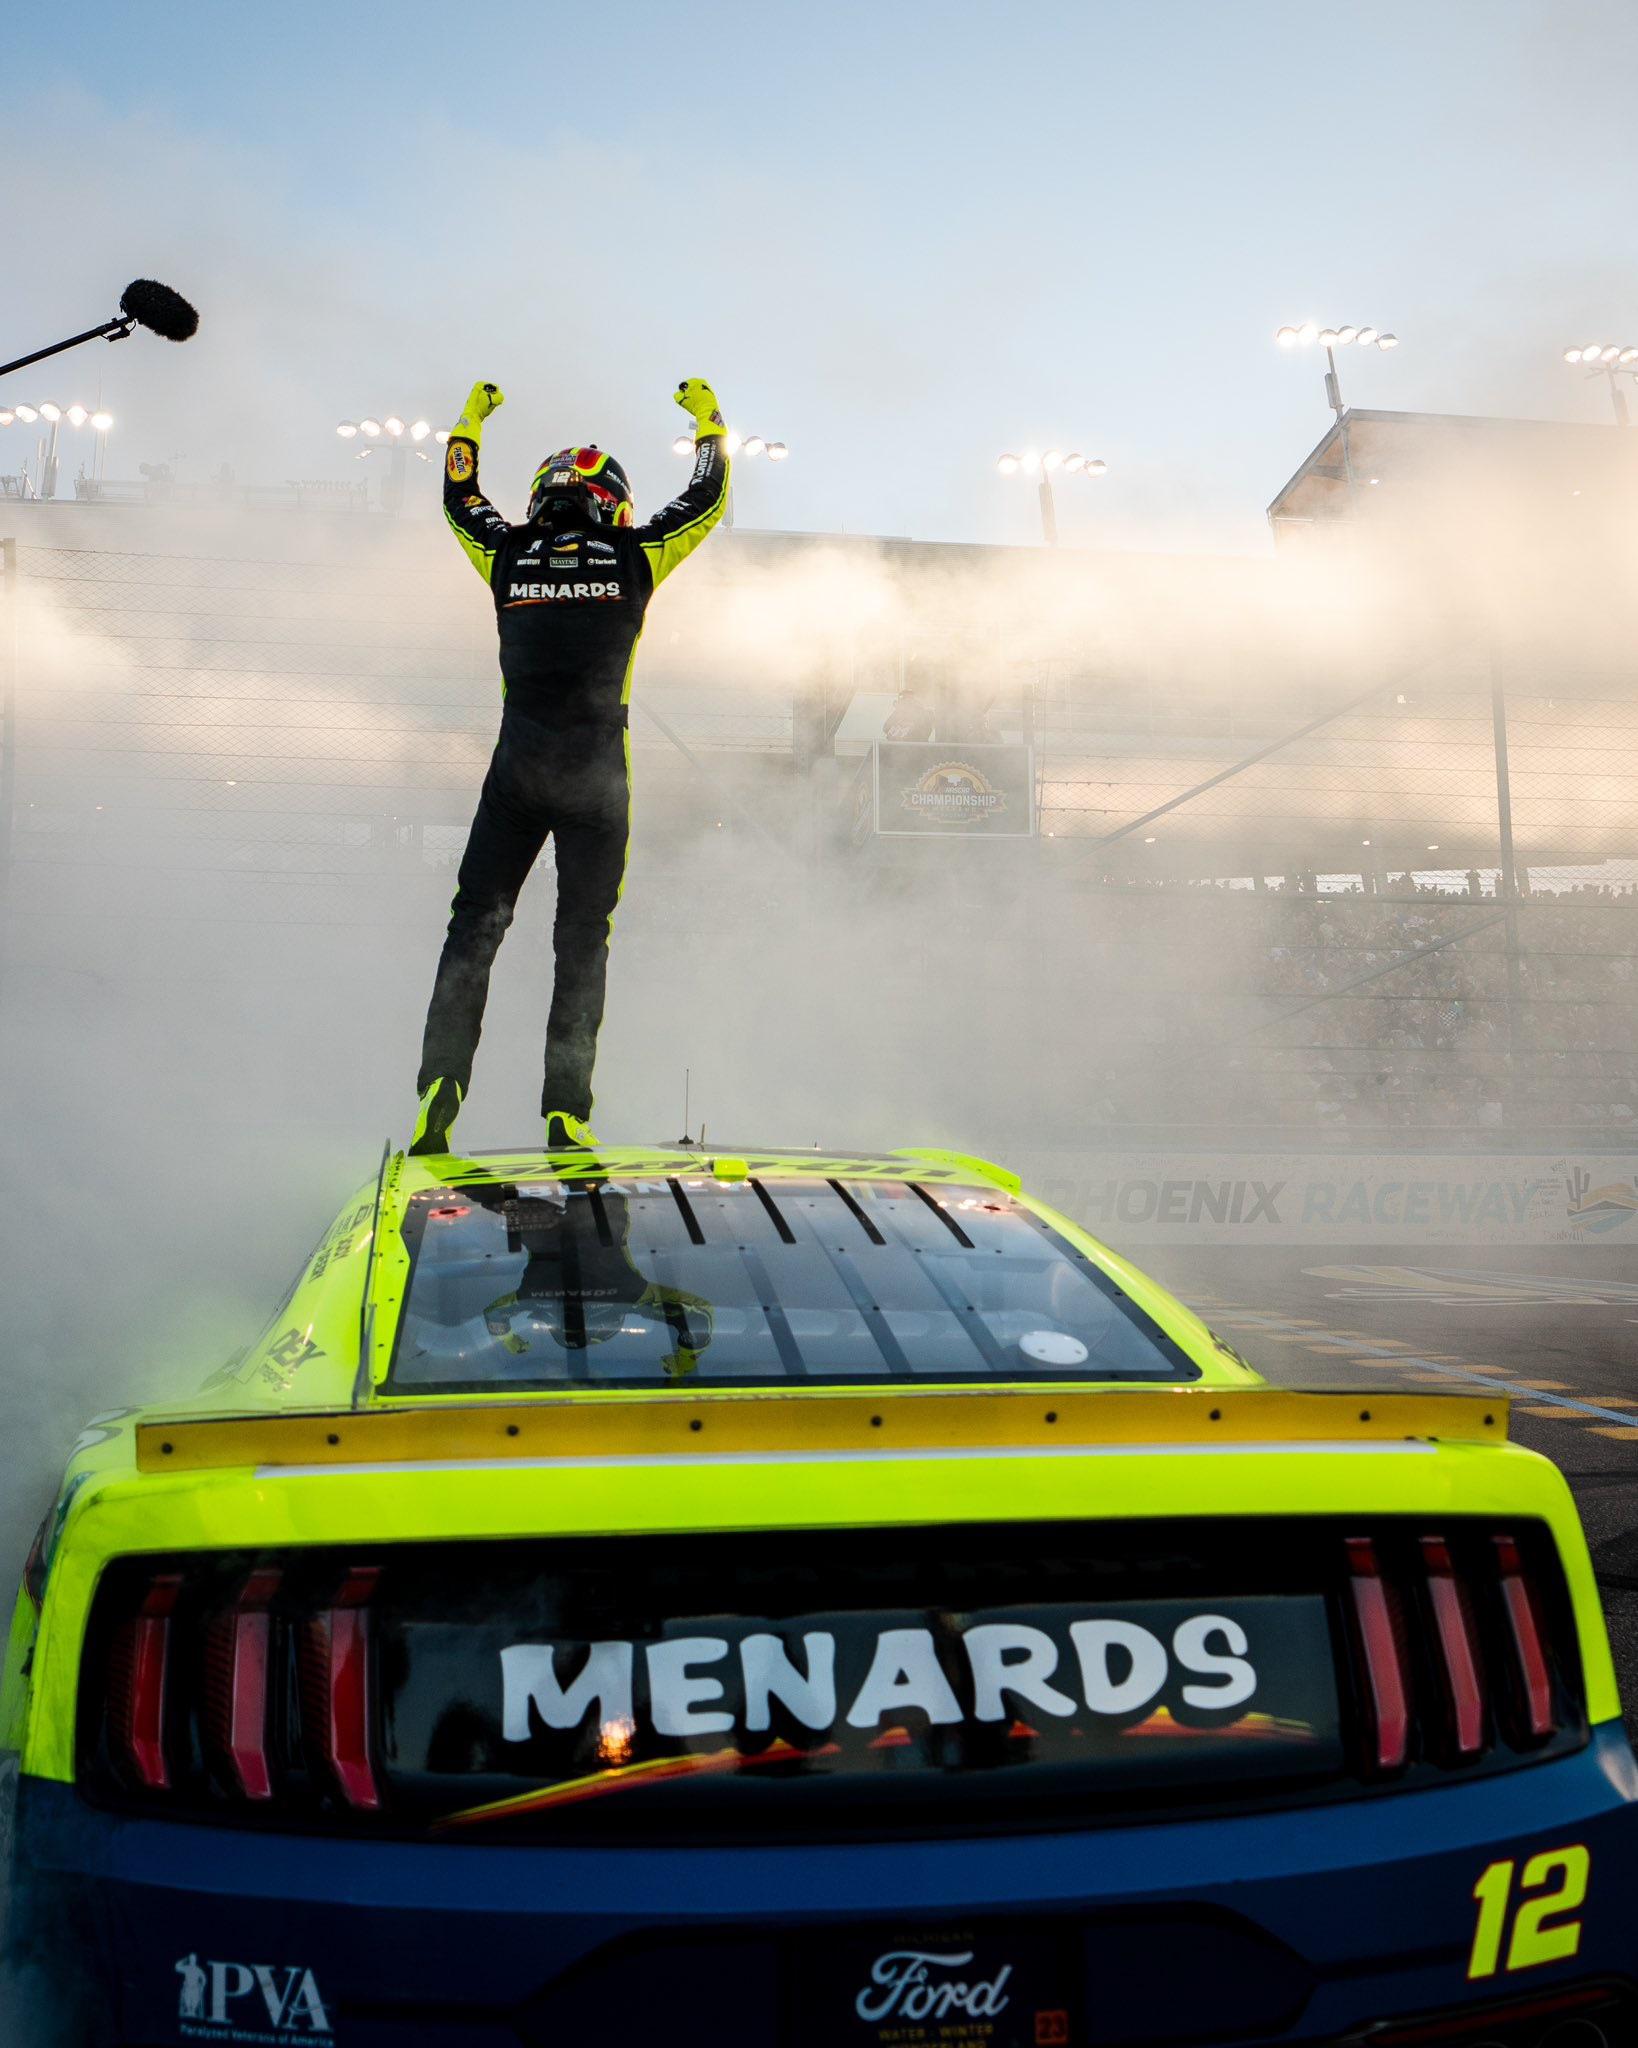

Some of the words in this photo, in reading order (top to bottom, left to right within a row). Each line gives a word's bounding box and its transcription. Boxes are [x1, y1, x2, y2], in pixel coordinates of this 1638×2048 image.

[551, 471, 571, 484] 12
[509, 582, 620, 598] MENARDS
[911, 793, 997, 807] CHAMPIONSHIP
[516, 1181, 753, 1197] BLANEY
[1042, 1179, 1287, 1224] PHOENIX
[1301, 1181, 1541, 1225] RACEWAY
[499, 1614, 1257, 1741] MENARDS
[1467, 1844, 1590, 1980] 12
[207, 1960, 334, 2032] PVA
[856, 1950, 1013, 2022] Ford
[231, 2030, 276, 2043] Veterans
[290, 2034, 334, 2048] America
